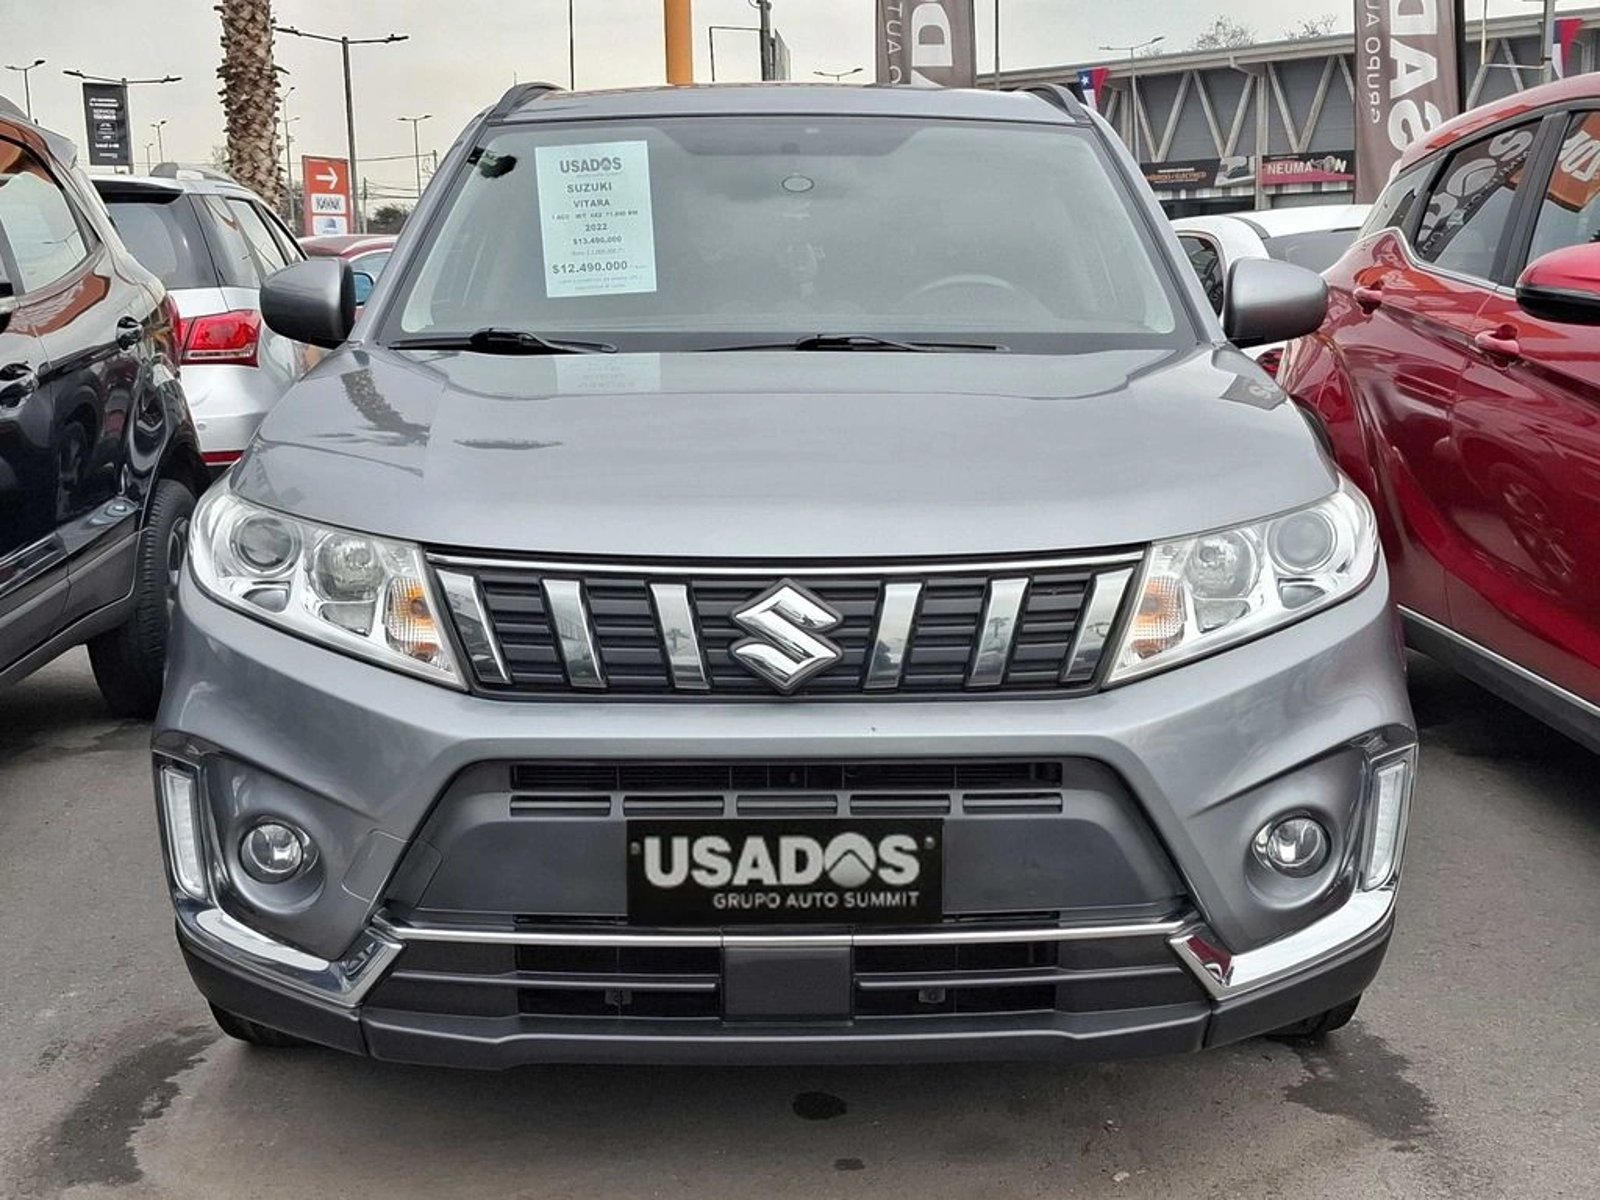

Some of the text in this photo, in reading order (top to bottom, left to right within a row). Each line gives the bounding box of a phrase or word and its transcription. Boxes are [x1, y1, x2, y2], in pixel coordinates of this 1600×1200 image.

[560, 157, 622, 174] USADOS
[567, 182, 612, 194] SUZUKI
[573, 199, 611, 208] VITARA
[585, 223, 607, 232] 2022
[552, 259, 628, 275] $12.490.000
[644, 832, 920, 888] USADOS
[713, 891, 920, 909] GRUPO AUTO SUMMIT
